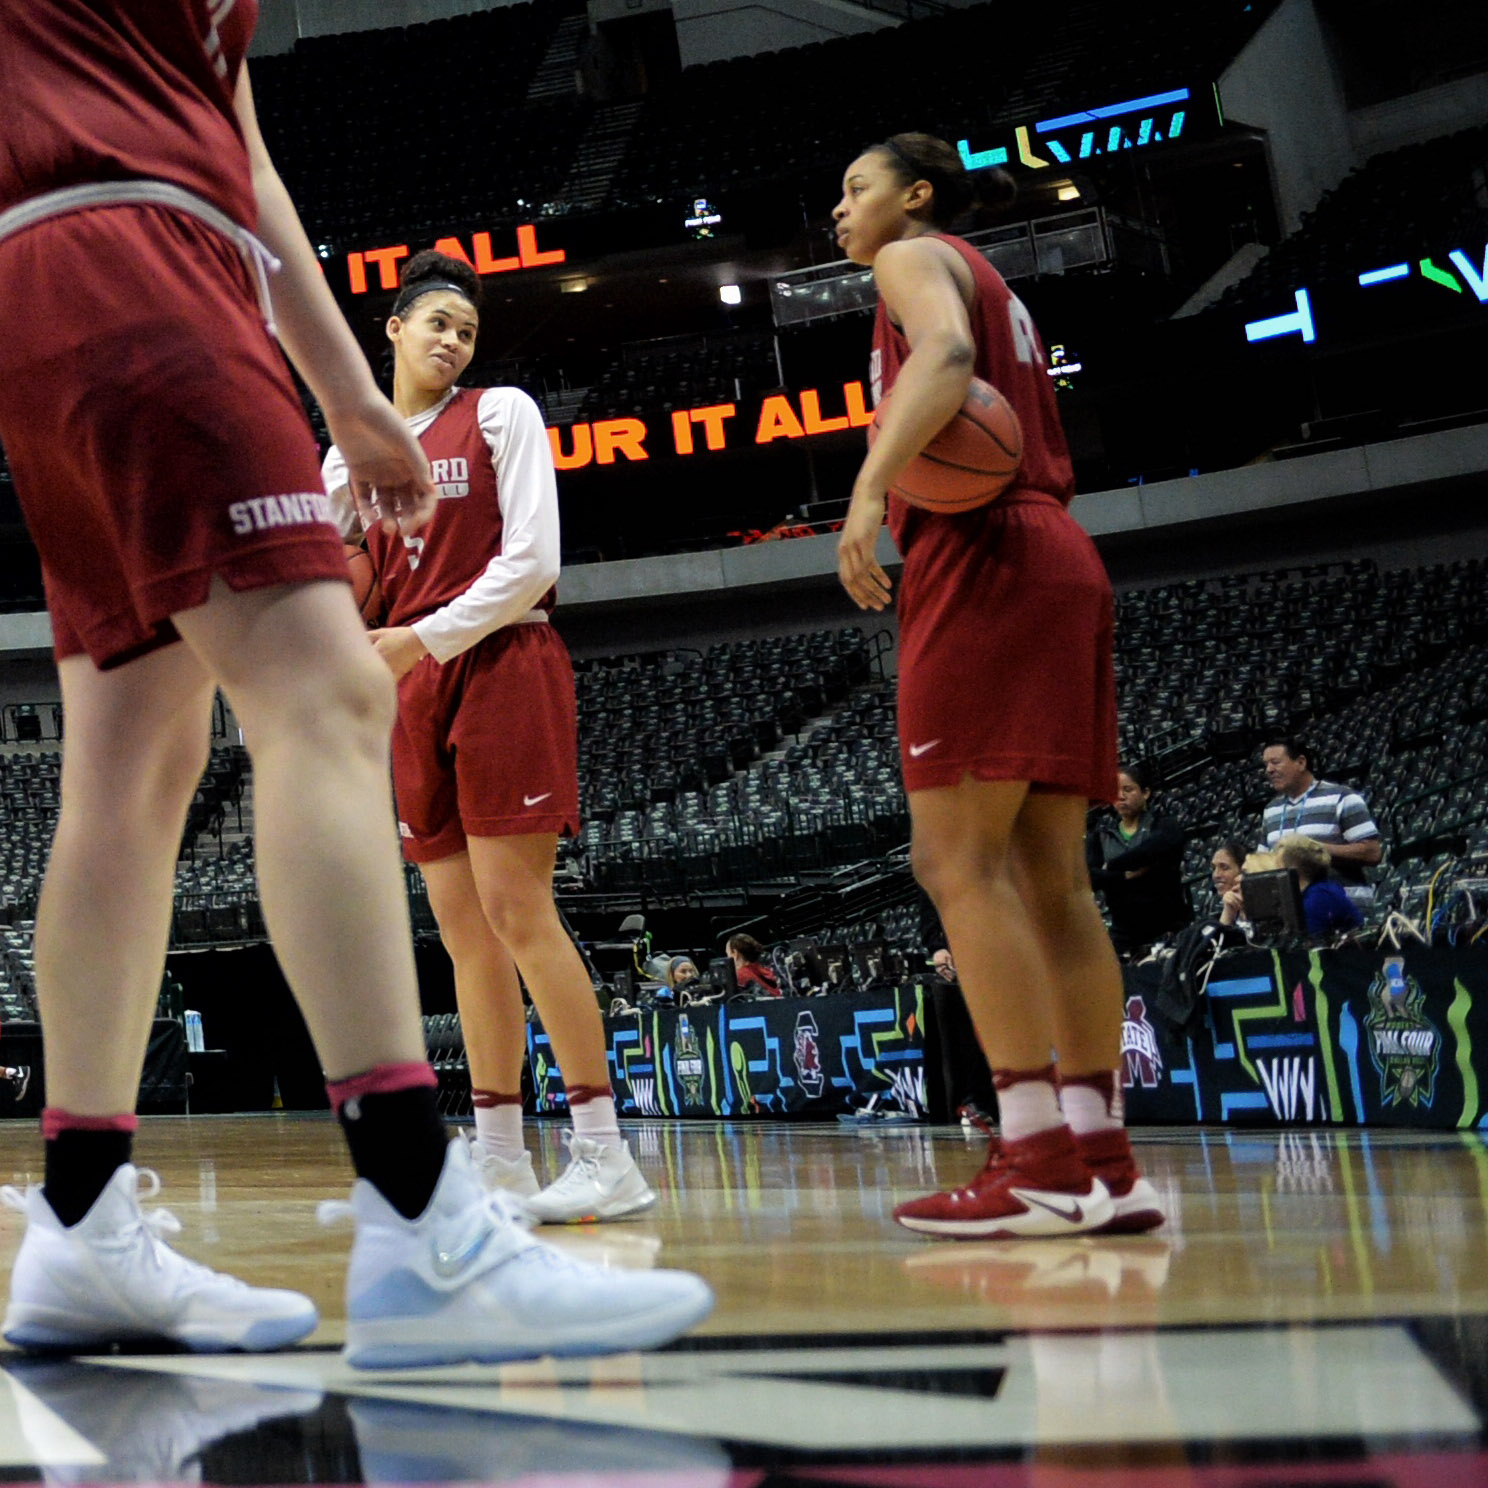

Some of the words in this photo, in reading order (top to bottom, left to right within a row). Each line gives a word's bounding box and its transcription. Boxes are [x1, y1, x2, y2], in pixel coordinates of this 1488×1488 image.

[346, 244, 410, 294] IT
[545, 417, 649, 471] UR
[671, 403, 736, 455] IT
[755, 380, 876, 445] ALL
